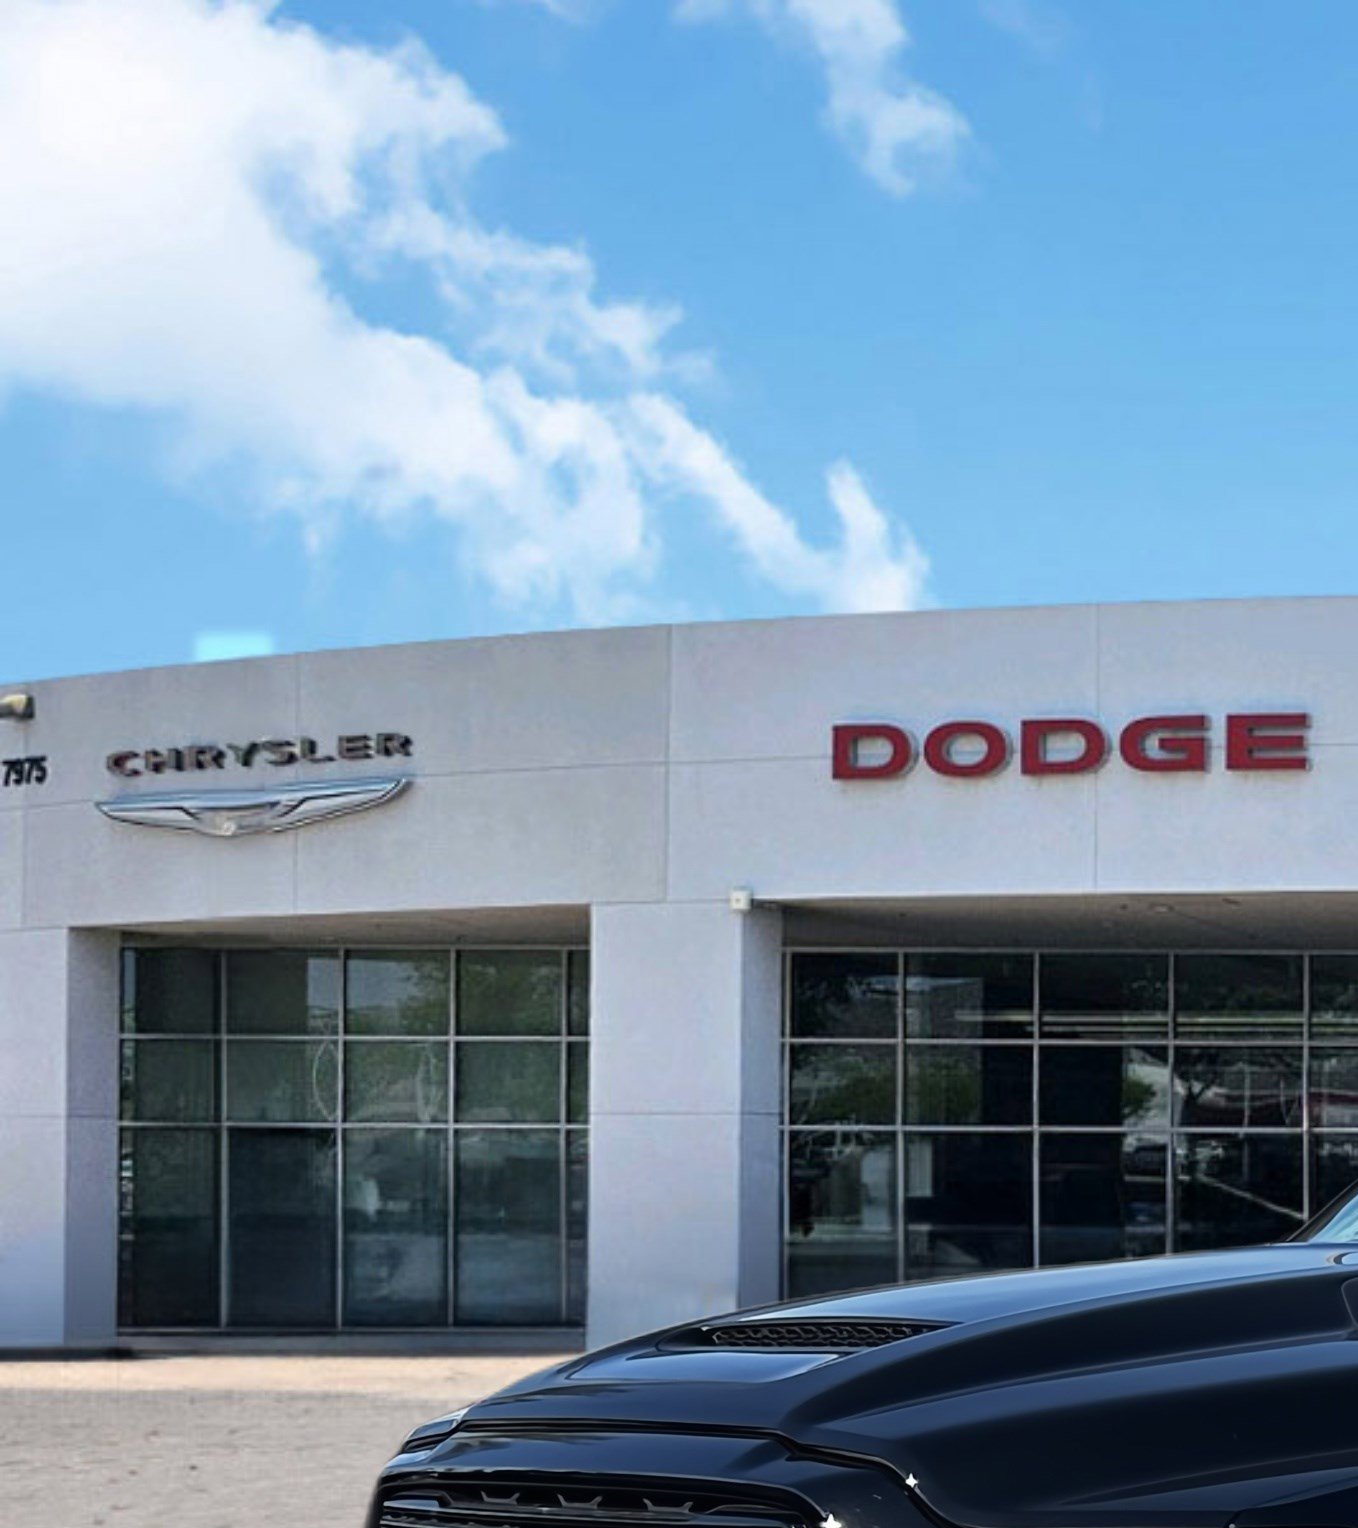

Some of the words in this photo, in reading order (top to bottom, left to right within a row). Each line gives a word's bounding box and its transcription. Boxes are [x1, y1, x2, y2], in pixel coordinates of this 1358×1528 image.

[105, 732, 414, 777] CHRYSLER
[831, 712, 1313, 781] DODGE
[2, 756, 48, 788] 7975
